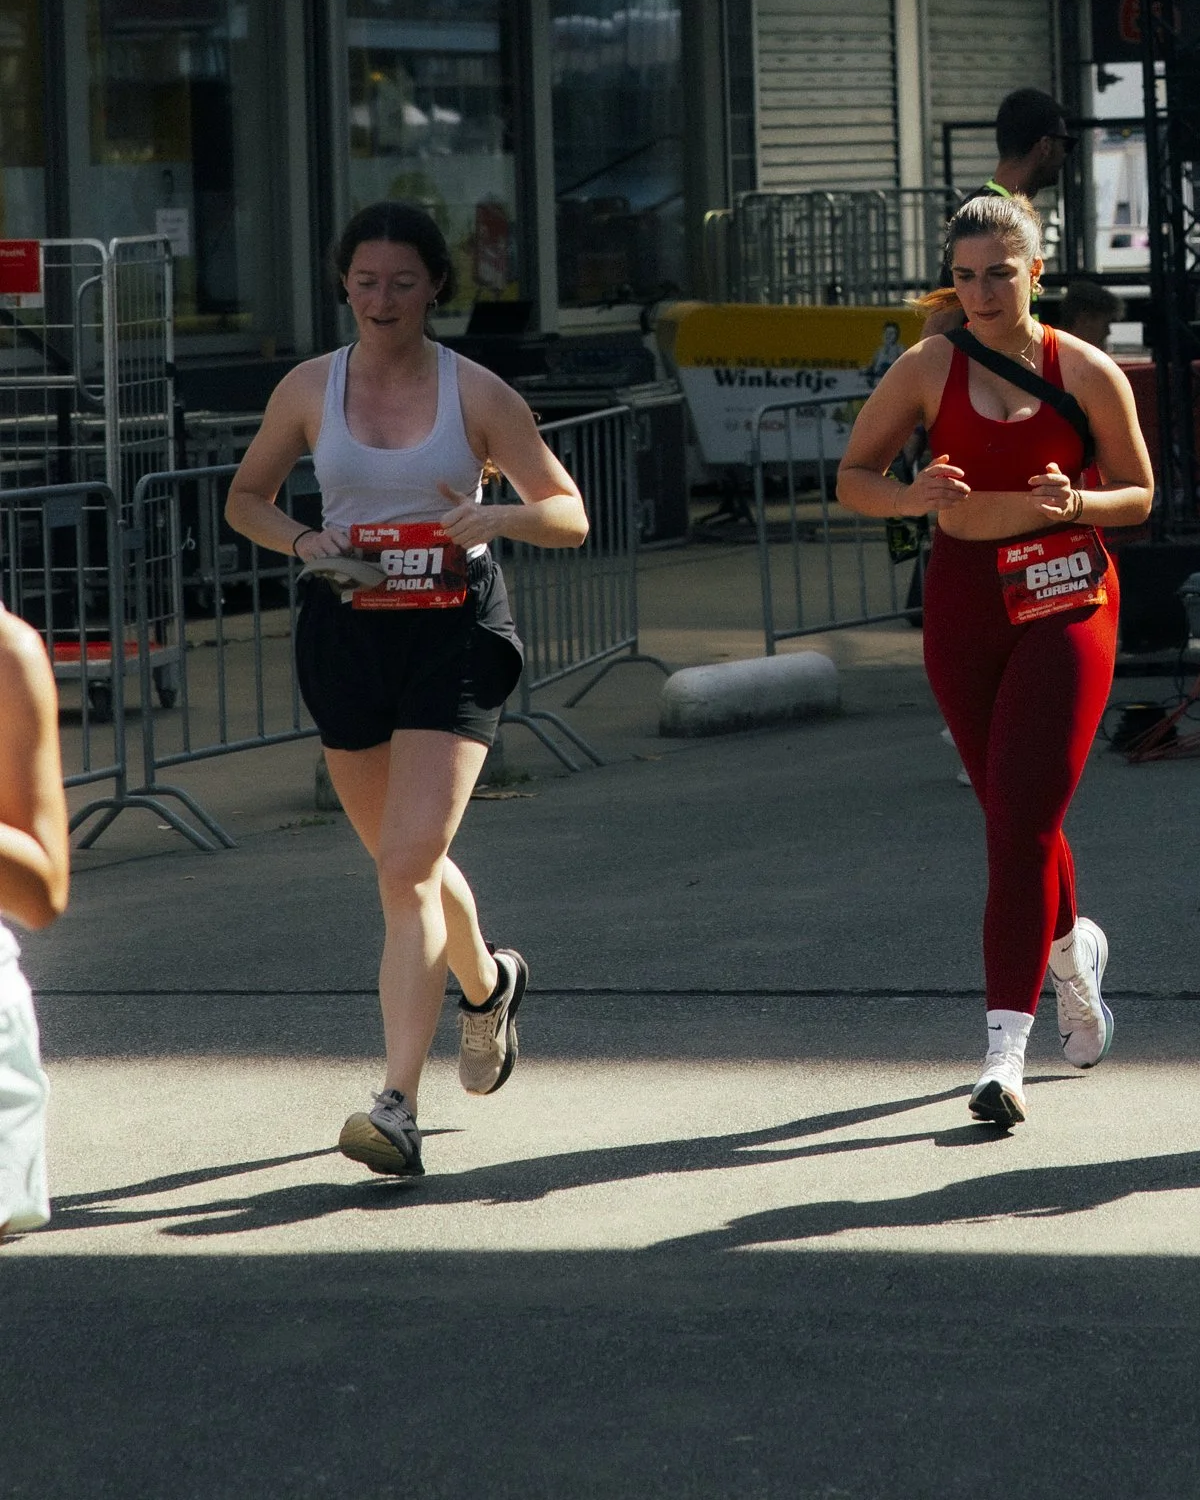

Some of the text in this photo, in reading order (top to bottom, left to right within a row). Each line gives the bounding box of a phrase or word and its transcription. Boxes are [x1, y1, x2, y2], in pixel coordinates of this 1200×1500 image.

[381, 547, 444, 576] 691
[1026, 551, 1092, 590] 690
[387, 578, 434, 591] PAOLA
[1036, 579, 1089, 600] LORENA
